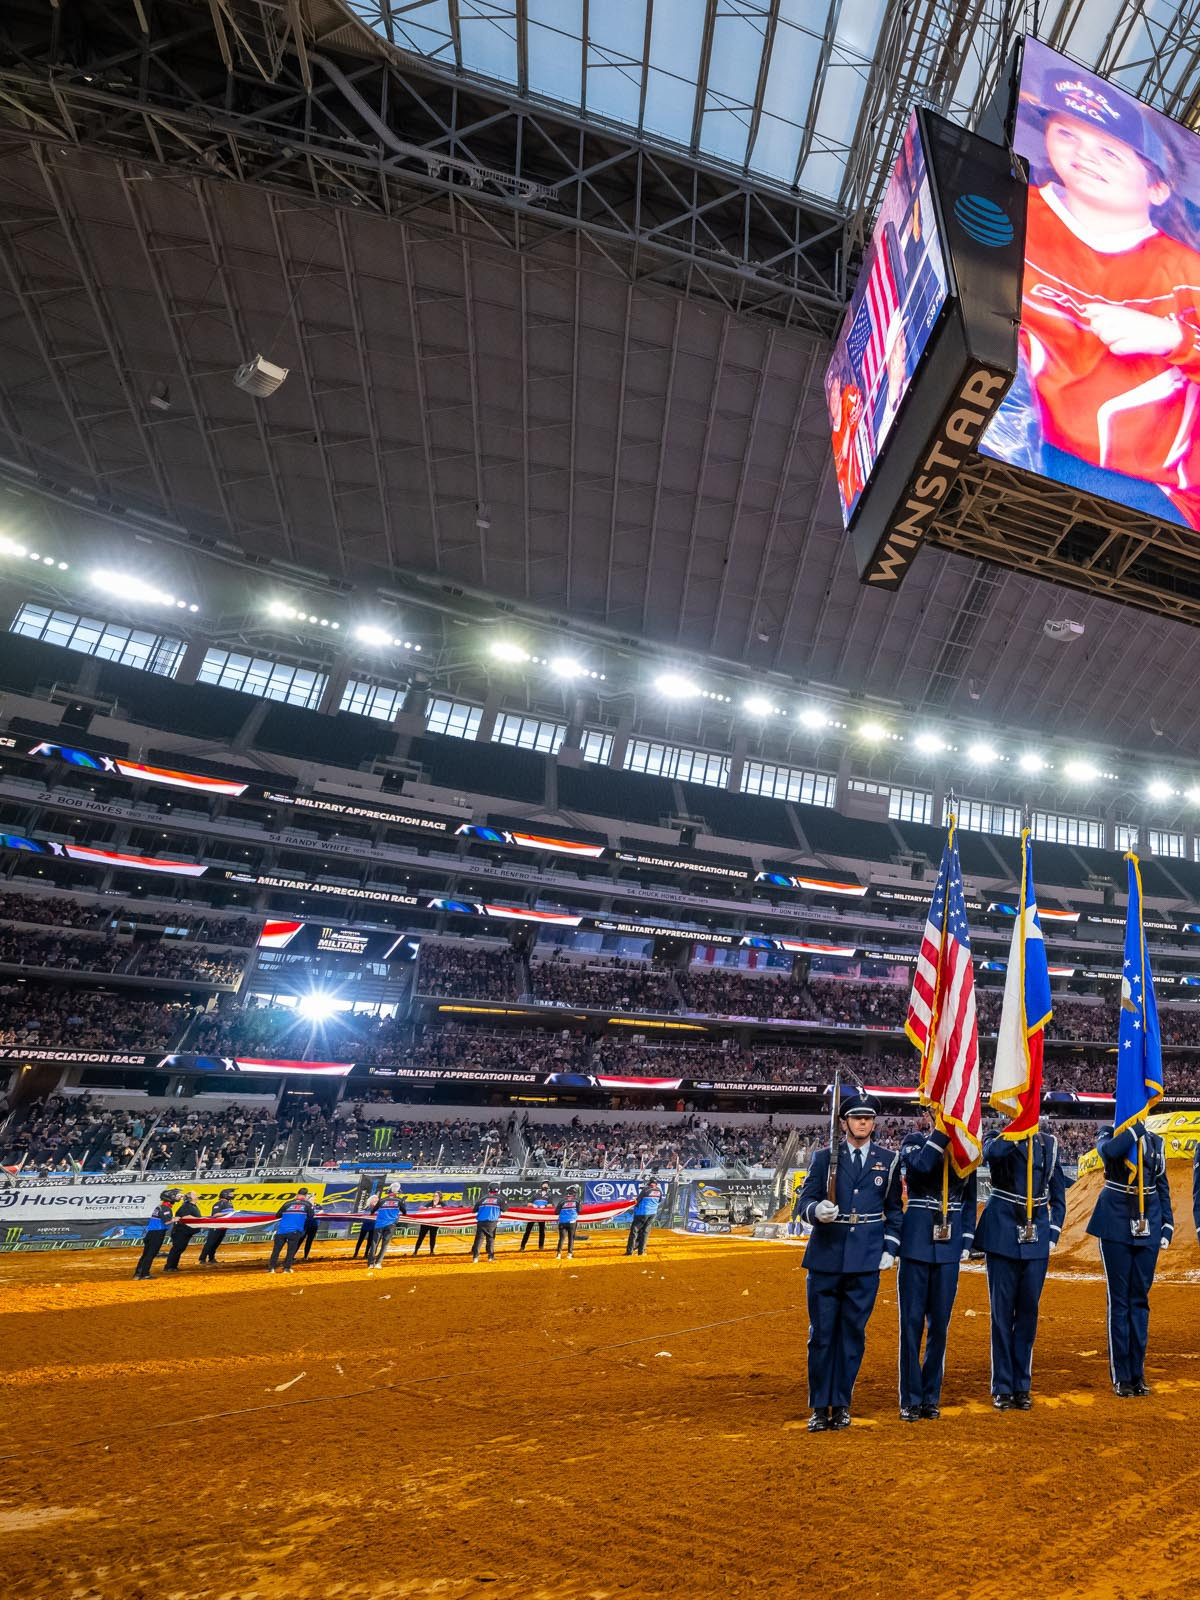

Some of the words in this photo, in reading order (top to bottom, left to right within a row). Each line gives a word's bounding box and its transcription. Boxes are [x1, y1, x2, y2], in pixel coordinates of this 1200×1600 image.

[869, 370, 1006, 581] WINSTAR
[0, 737, 16, 747] CE
[57, 796, 83, 806] BOB
[86, 802, 122, 815] HAYES
[295, 797, 347, 813] MILITARY
[346, 806, 421, 826] APPRECIATION
[420, 819, 446, 831] RACE
[285, 836, 318, 847] RANDY
[321, 842, 351, 852] WHITE
[638, 856, 674, 867] MILITARY
[673, 861, 728, 875] APPRECIATION
[729, 870, 748, 878] RACE
[483, 868, 498, 876] MEL
[501, 870, 530, 879] RENFRO
[257, 877, 311, 890] MILITARY
[311, 884, 390, 901] APPRECIATION
[391, 894, 417, 904] RACE
[638, 889, 659, 897] CHUCK
[661, 891, 686, 901] HOWLEY
[894, 894, 923, 902] MILITARY
[1103, 917, 1127, 925] MILITARY
[617, 924, 655, 935] MILITARY
[655, 929, 712, 942] APPRECIATION
[712, 935, 732, 943] RACE
[318, 939, 367, 950] MILITARY
[883, 953, 912, 962] MILITARY
[8, 1049, 110, 1063] APPRECIATION
[111, 1055, 146, 1064] RACE
[397, 1069, 442, 1078] MILITARY
[443, 1072, 512, 1081] APPRECIATION
[748, 1084, 799, 1092] APPRECIATION
[198, 1193, 316, 1201] DNLO
[497, 1187, 562, 1196] ONSTR
[20, 1194, 146, 1206] Husqvarna
